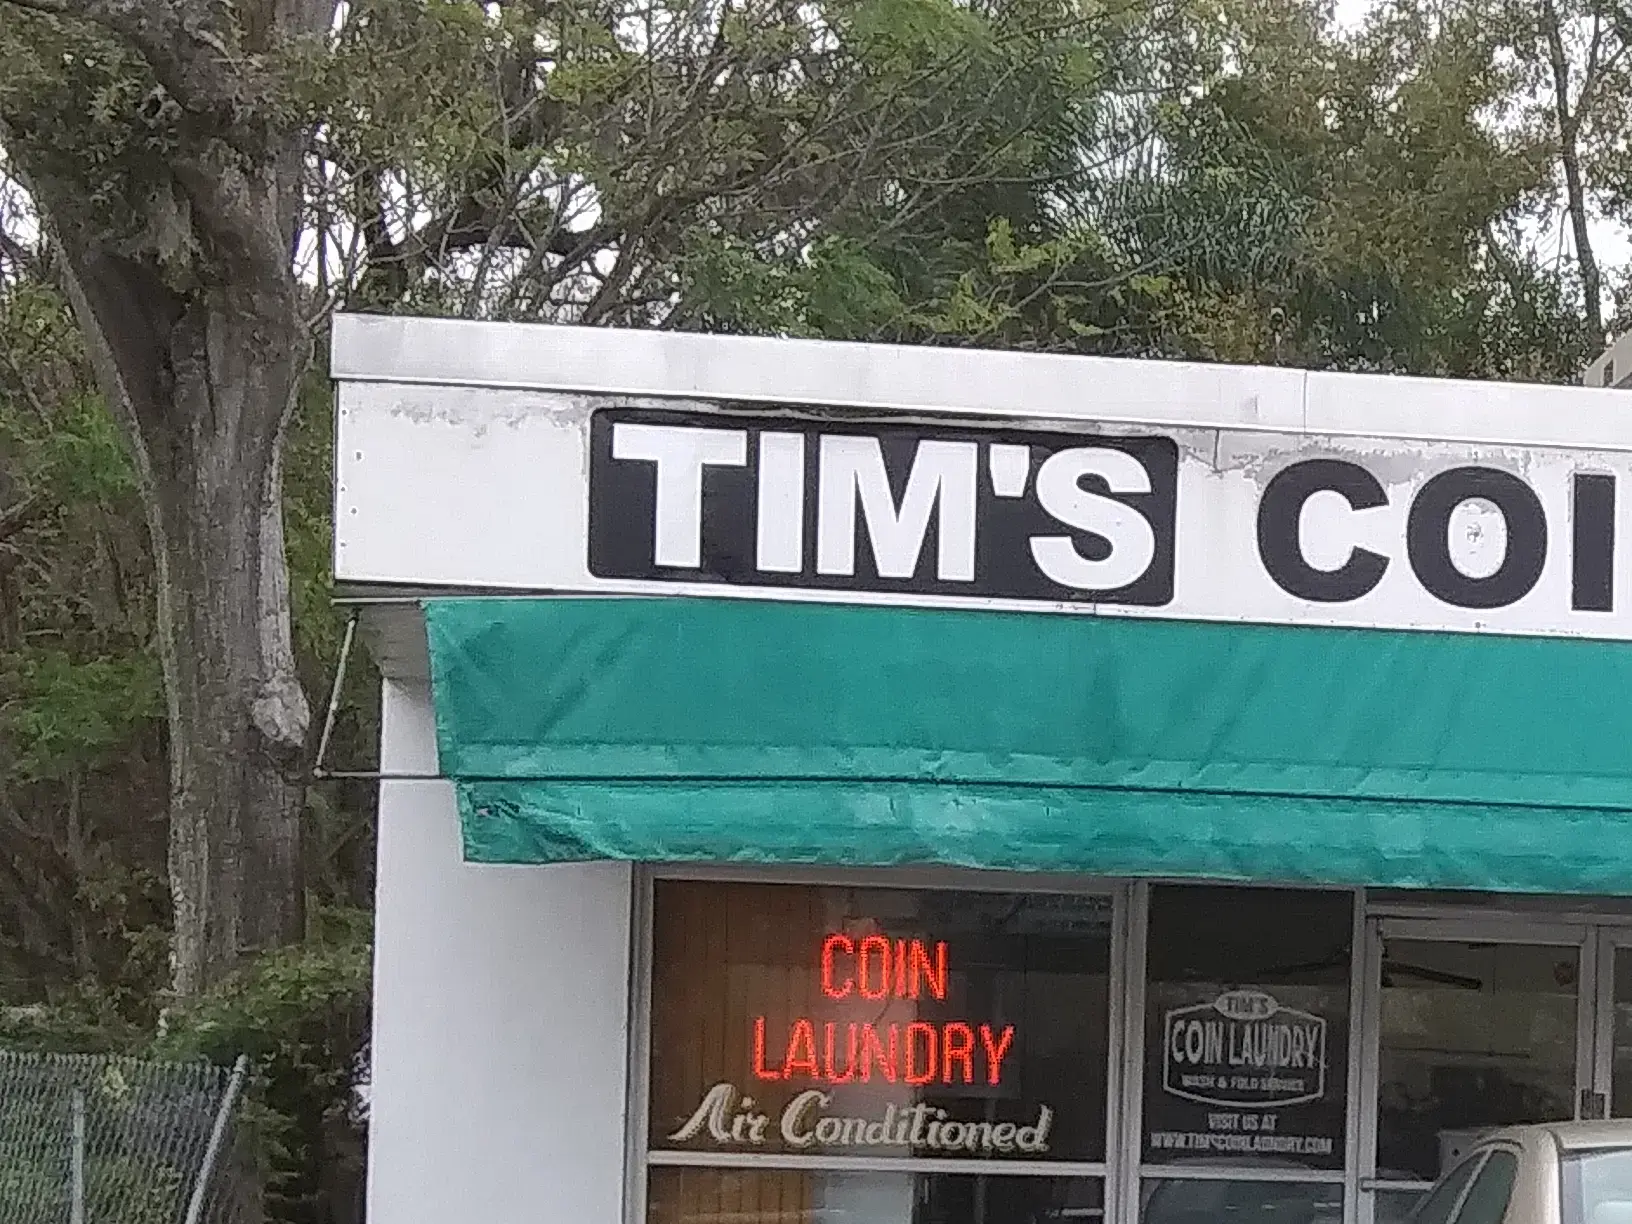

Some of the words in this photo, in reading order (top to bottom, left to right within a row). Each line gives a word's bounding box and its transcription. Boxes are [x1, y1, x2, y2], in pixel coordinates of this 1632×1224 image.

[613, 422, 1155, 590] TIM'S
[820, 934, 949, 1001] COIN
[752, 1016, 1016, 1086] LAUNDRY
[1171, 1019, 1223, 1064] COIN
[1229, 1021, 1319, 1069] LAUNDRY
[668, 1082, 770, 1144] Air
[780, 1089, 1055, 1152] Conditioned
[1261, 1114, 1277, 1131] AT
